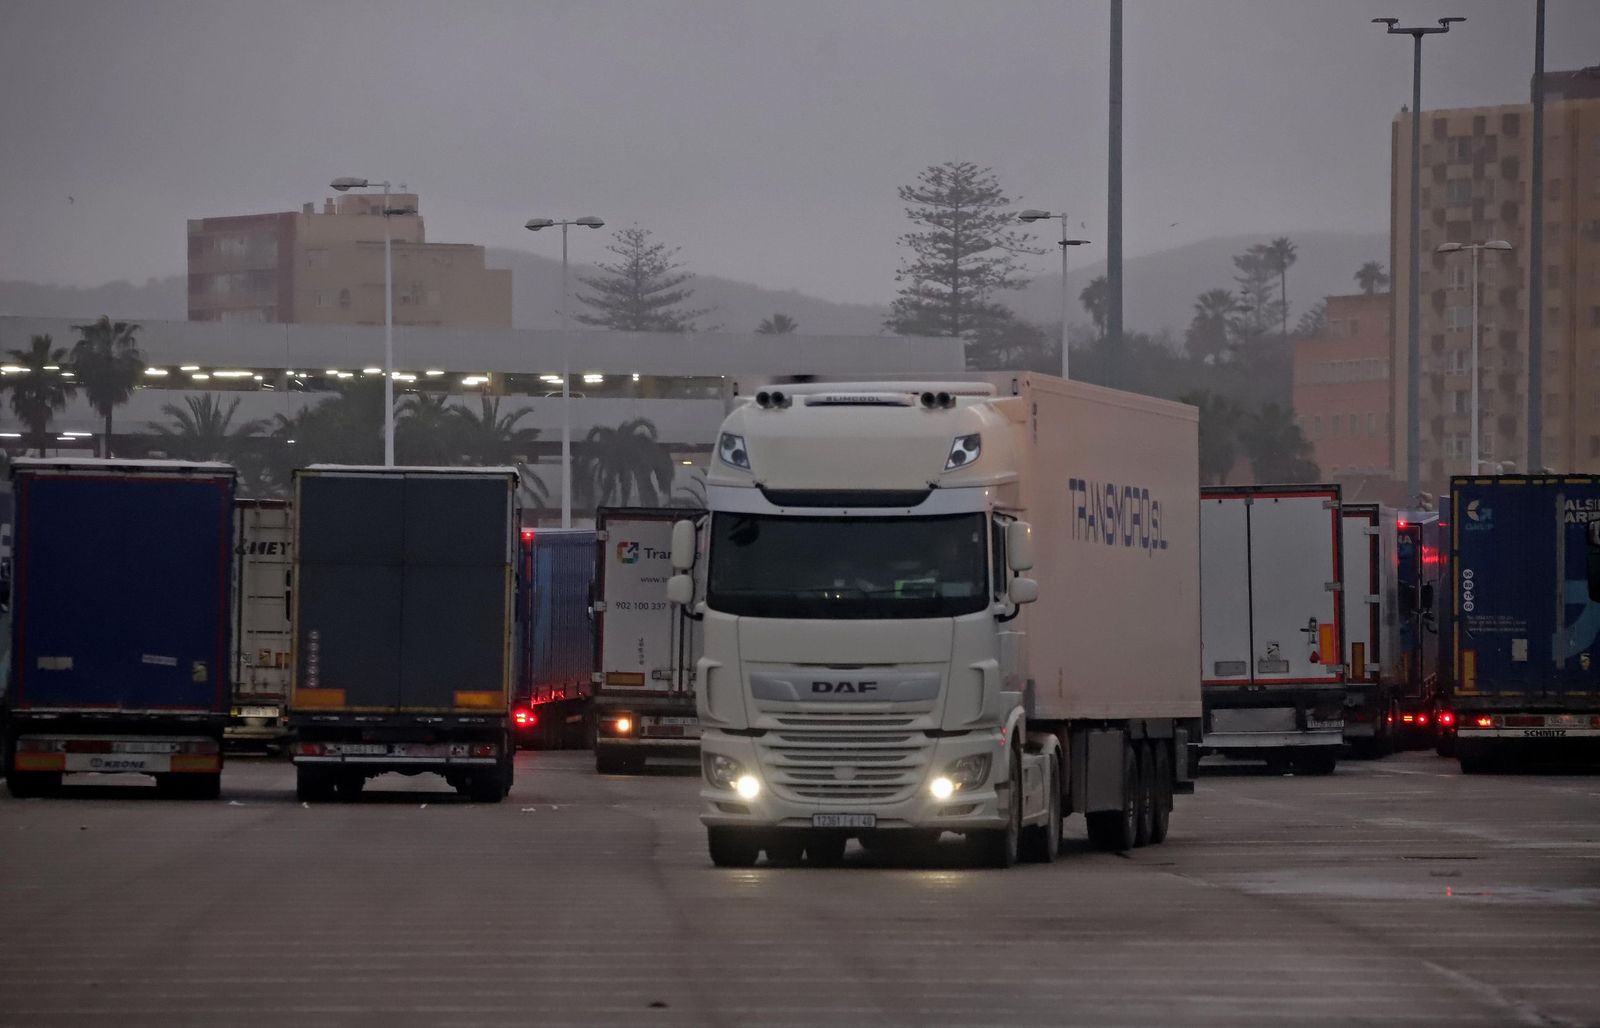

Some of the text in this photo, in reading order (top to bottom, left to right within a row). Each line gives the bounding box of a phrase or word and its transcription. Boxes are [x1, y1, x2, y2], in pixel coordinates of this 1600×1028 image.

[615, 602, 631, 610] 902
[634, 602, 649, 610] 100
[812, 681, 877, 693] DAF
[104, 760, 146, 769] KRONE
